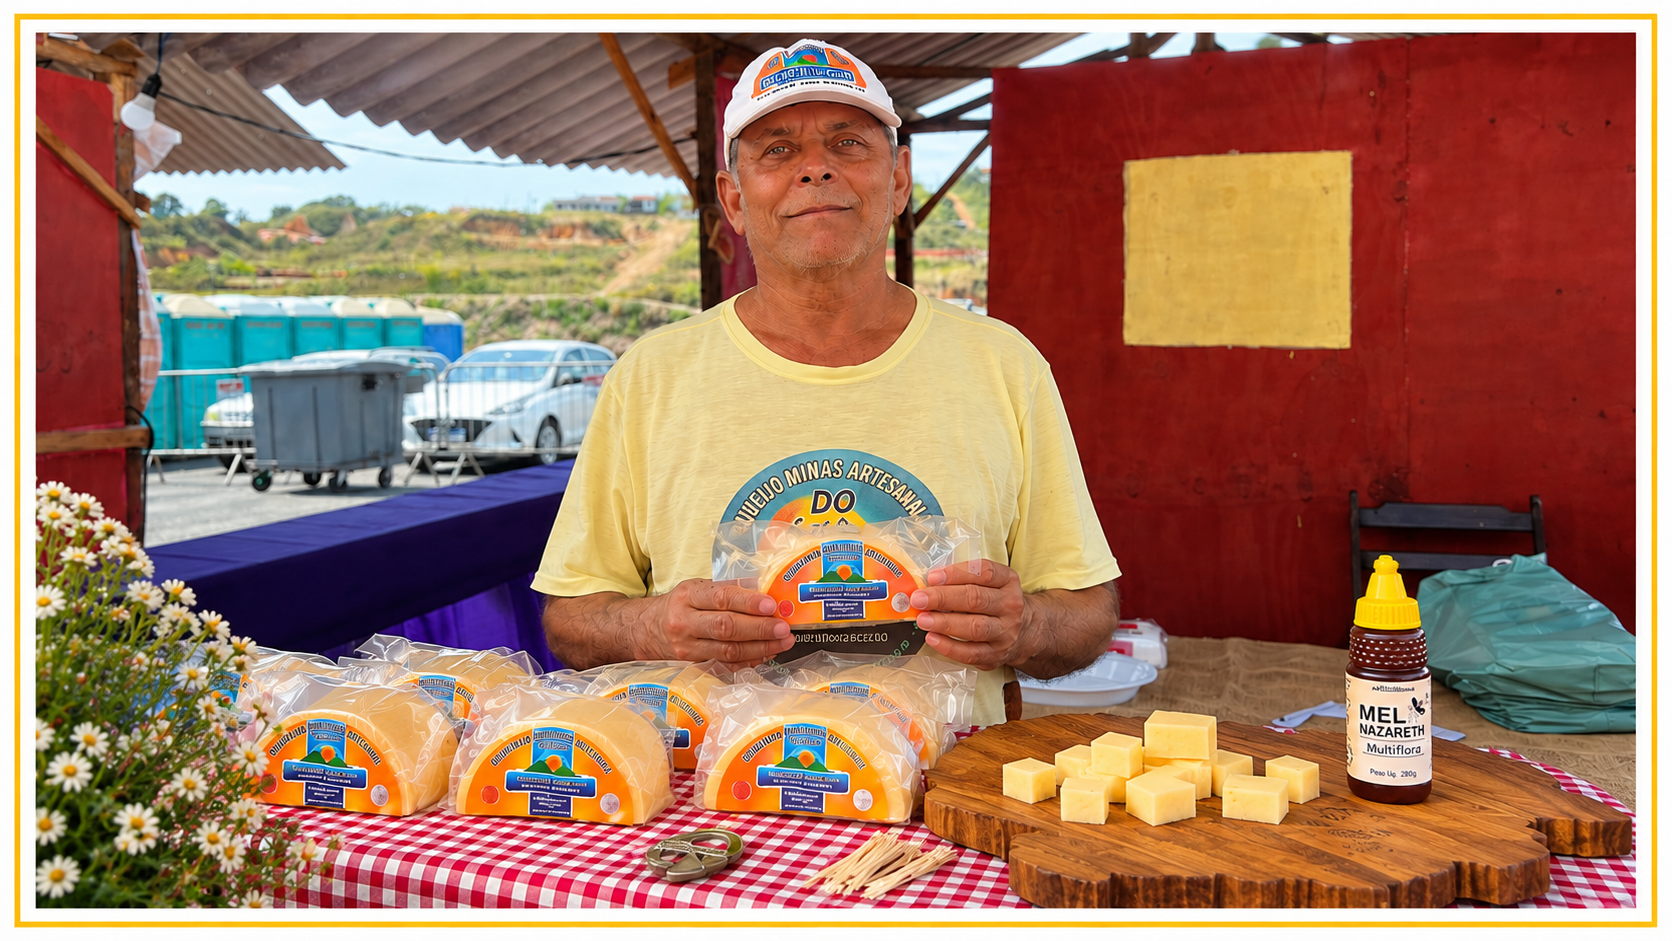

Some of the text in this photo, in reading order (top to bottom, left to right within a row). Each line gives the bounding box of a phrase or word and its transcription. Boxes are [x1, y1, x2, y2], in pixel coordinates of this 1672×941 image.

[783, 459, 844, 488] MINAS
[811, 489, 856, 514] DO
[1360, 704, 1406, 724] MEL
[1360, 723, 1425, 738] NAZARETH
[1367, 742, 1421, 755] Multiflora
